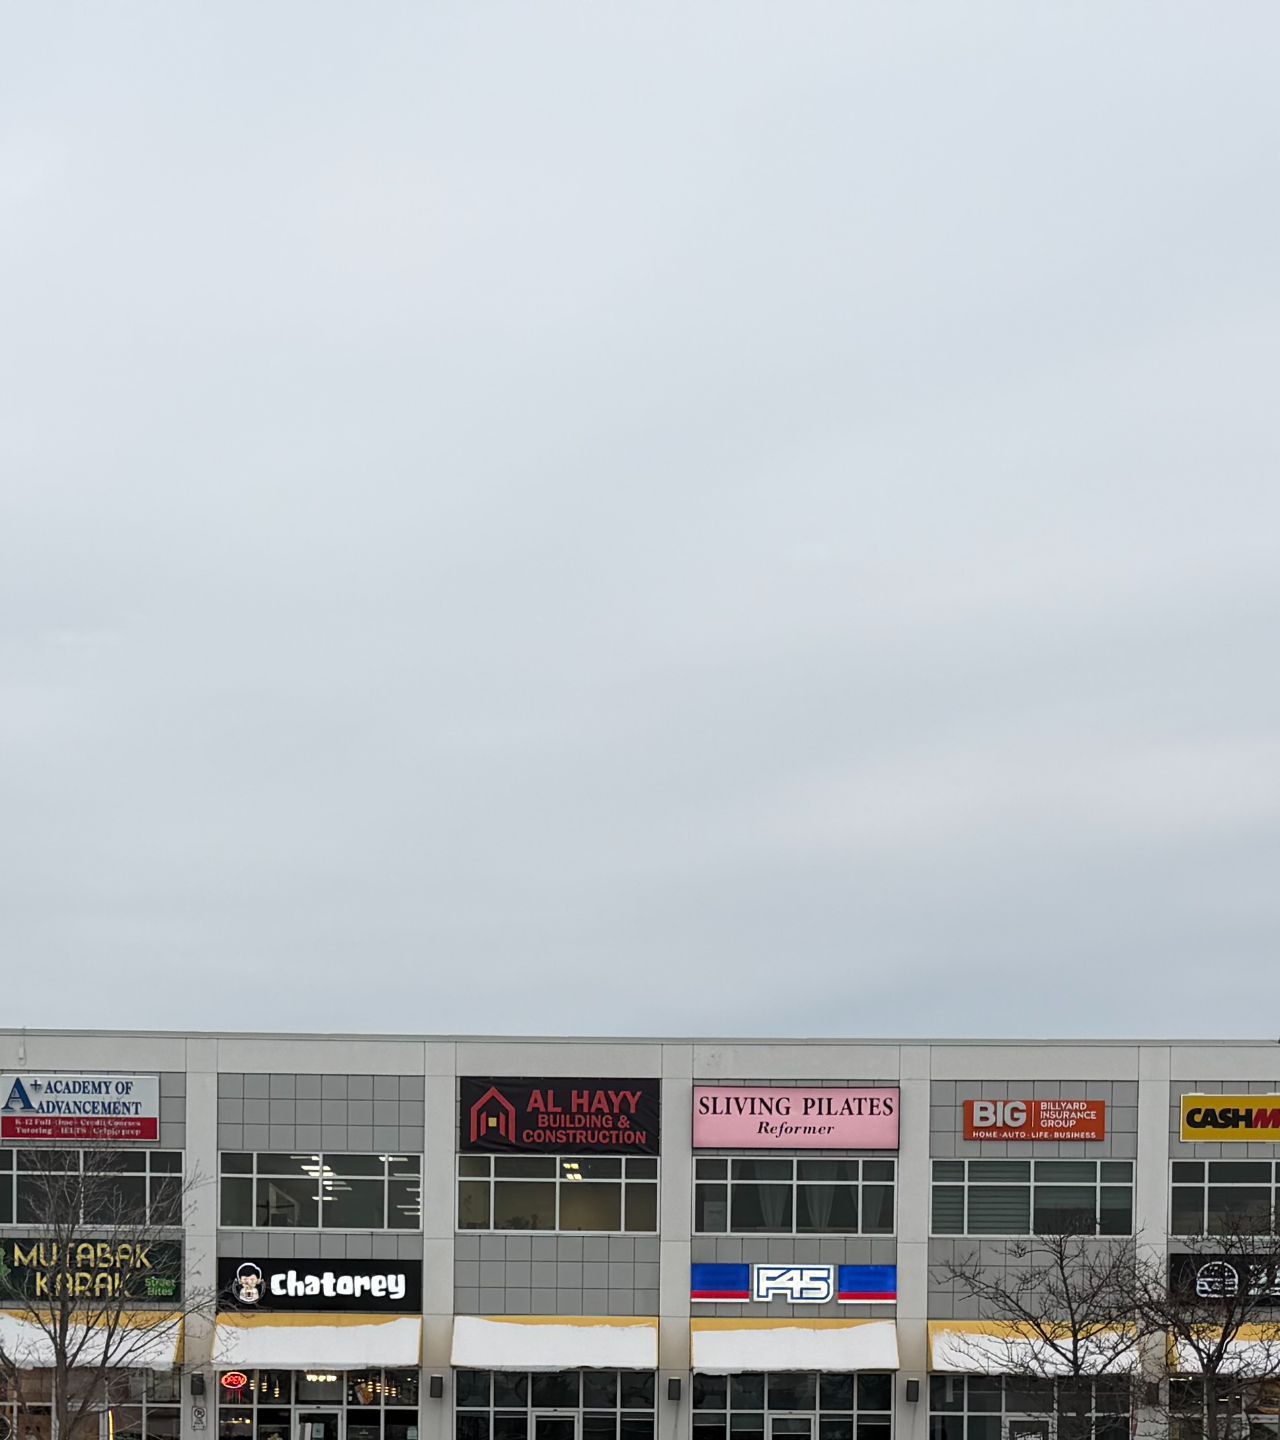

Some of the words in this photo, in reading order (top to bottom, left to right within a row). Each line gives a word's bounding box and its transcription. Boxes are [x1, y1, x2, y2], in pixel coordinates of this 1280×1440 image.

[44, 1080, 112, 1094] ACADEMY
[115, 1081, 134, 1095] OF
[36, 1100, 142, 1115] ADVANCEMENT
[527, 1089, 562, 1112] AL
[571, 1090, 642, 1113] HAYY
[699, 1096, 791, 1116] SLIVING
[803, 1097, 894, 1116] PILATES
[1040, 1102, 1087, 1110] BILLYARD
[973, 1101, 1027, 1127] BIG
[1040, 1111, 1097, 1119] INSURANCE
[538, 1115, 612, 1128] BUILDING
[617, 1115, 630, 1128] &
[1040, 1120, 1076, 1128] GROUP
[16, 1127, 52, 1135] Tutoring
[757, 1121, 835, 1138] Reformer
[523, 1130, 646, 1144] CONSTRUCTION
[755, 1266, 833, 1302] F45
[147, 1287, 173, 1296] Bites
[223, 1375, 246, 1385] OPEN
